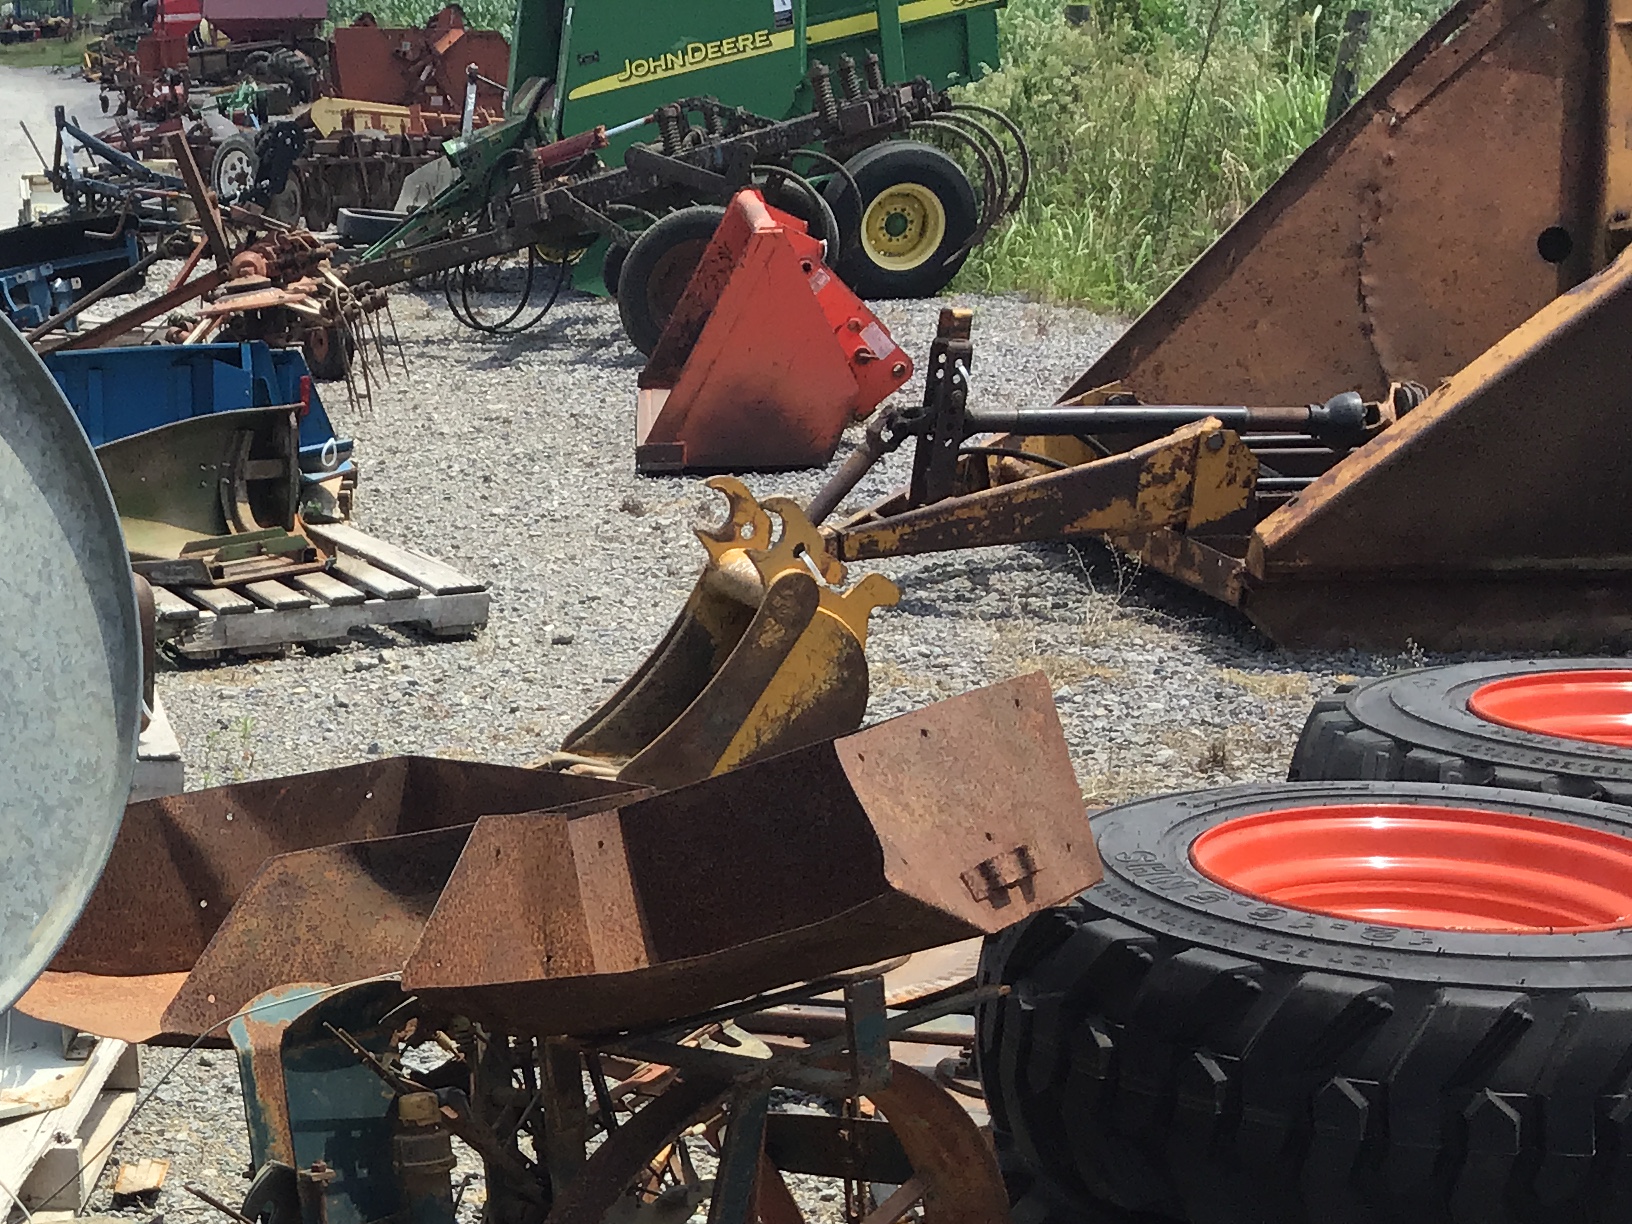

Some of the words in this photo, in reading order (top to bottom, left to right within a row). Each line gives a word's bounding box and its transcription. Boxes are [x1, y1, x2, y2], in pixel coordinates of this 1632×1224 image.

[617, 49, 686, 82] JOHN
[686, 29, 773, 64] DEERE
[1114, 849, 1200, 892] NHS
